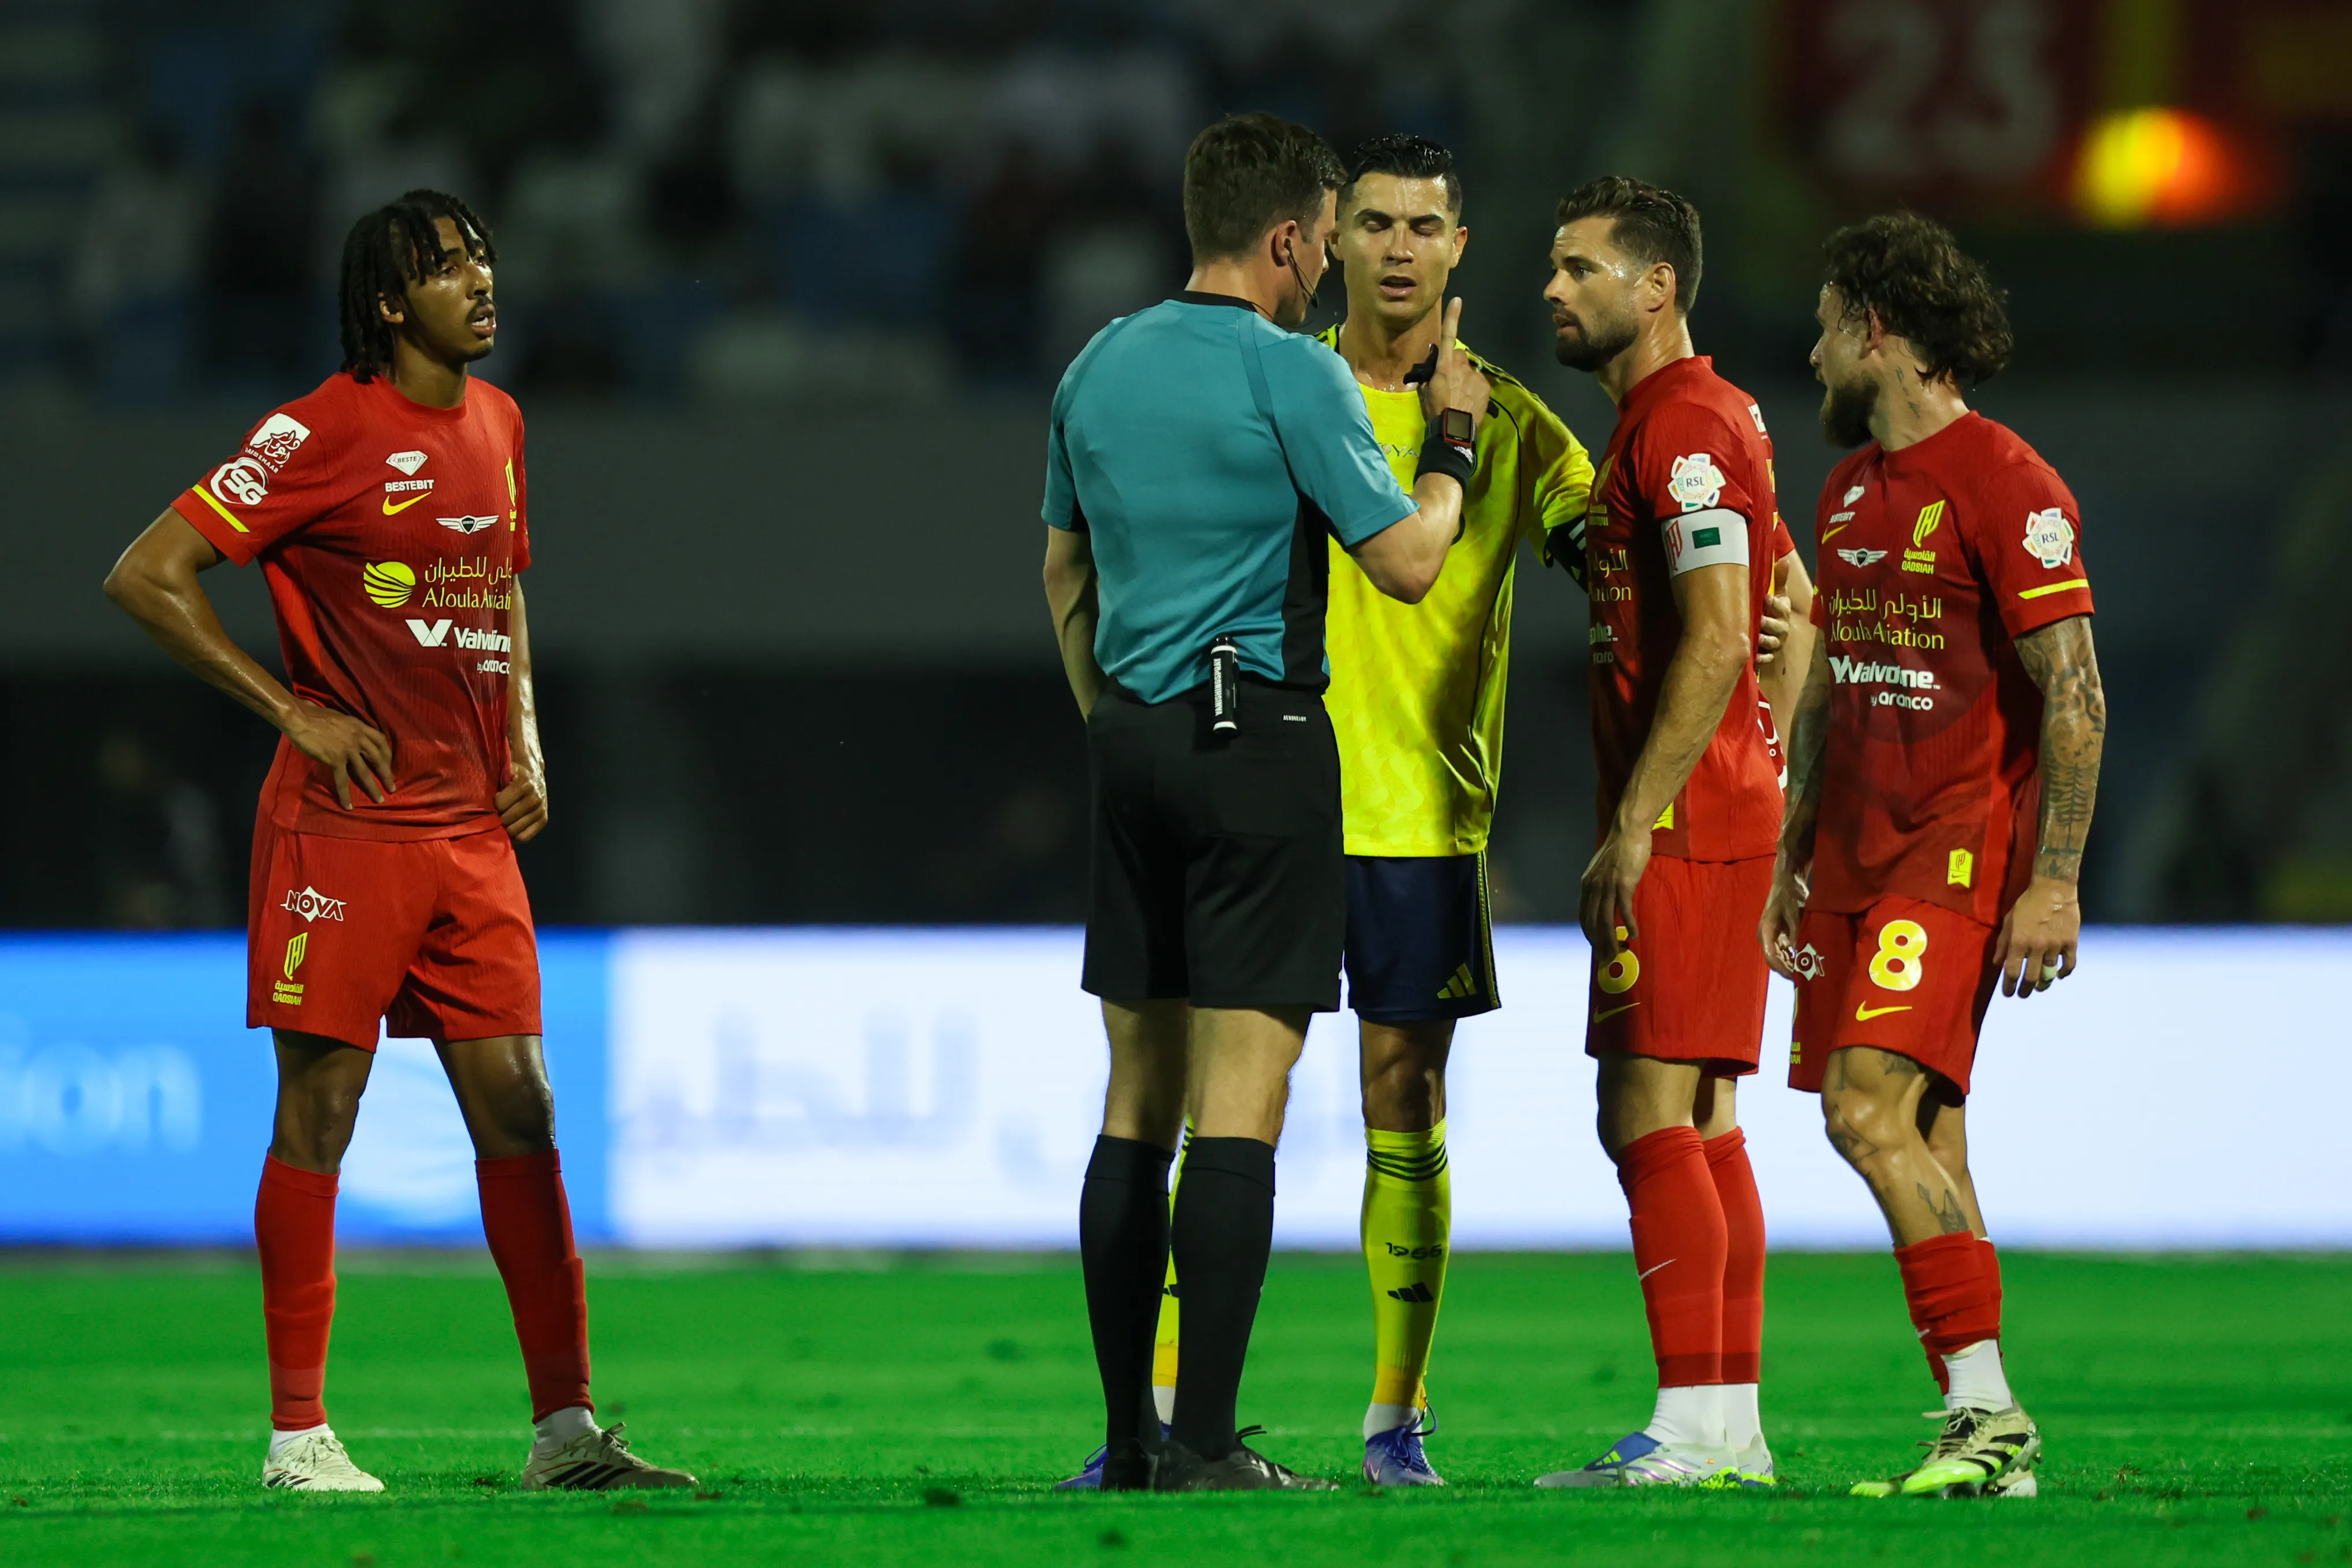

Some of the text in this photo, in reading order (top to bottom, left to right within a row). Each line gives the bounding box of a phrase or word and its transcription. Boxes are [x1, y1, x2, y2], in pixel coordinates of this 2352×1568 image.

[397, 455, 417, 463] BESTE
[385, 479, 434, 492] BESTEBIT
[1686, 477, 1705, 488] RSL
[2042, 532, 2060, 544] RSL
[425, 556, 487, 586] للطيران
[1901, 561, 1934, 575] QADSIAH
[421, 586, 480, 608] Aloula
[286, 889, 344, 922] NOVA
[1868, 919, 1927, 991] 8
[273, 992, 302, 1006] QADSIAH
